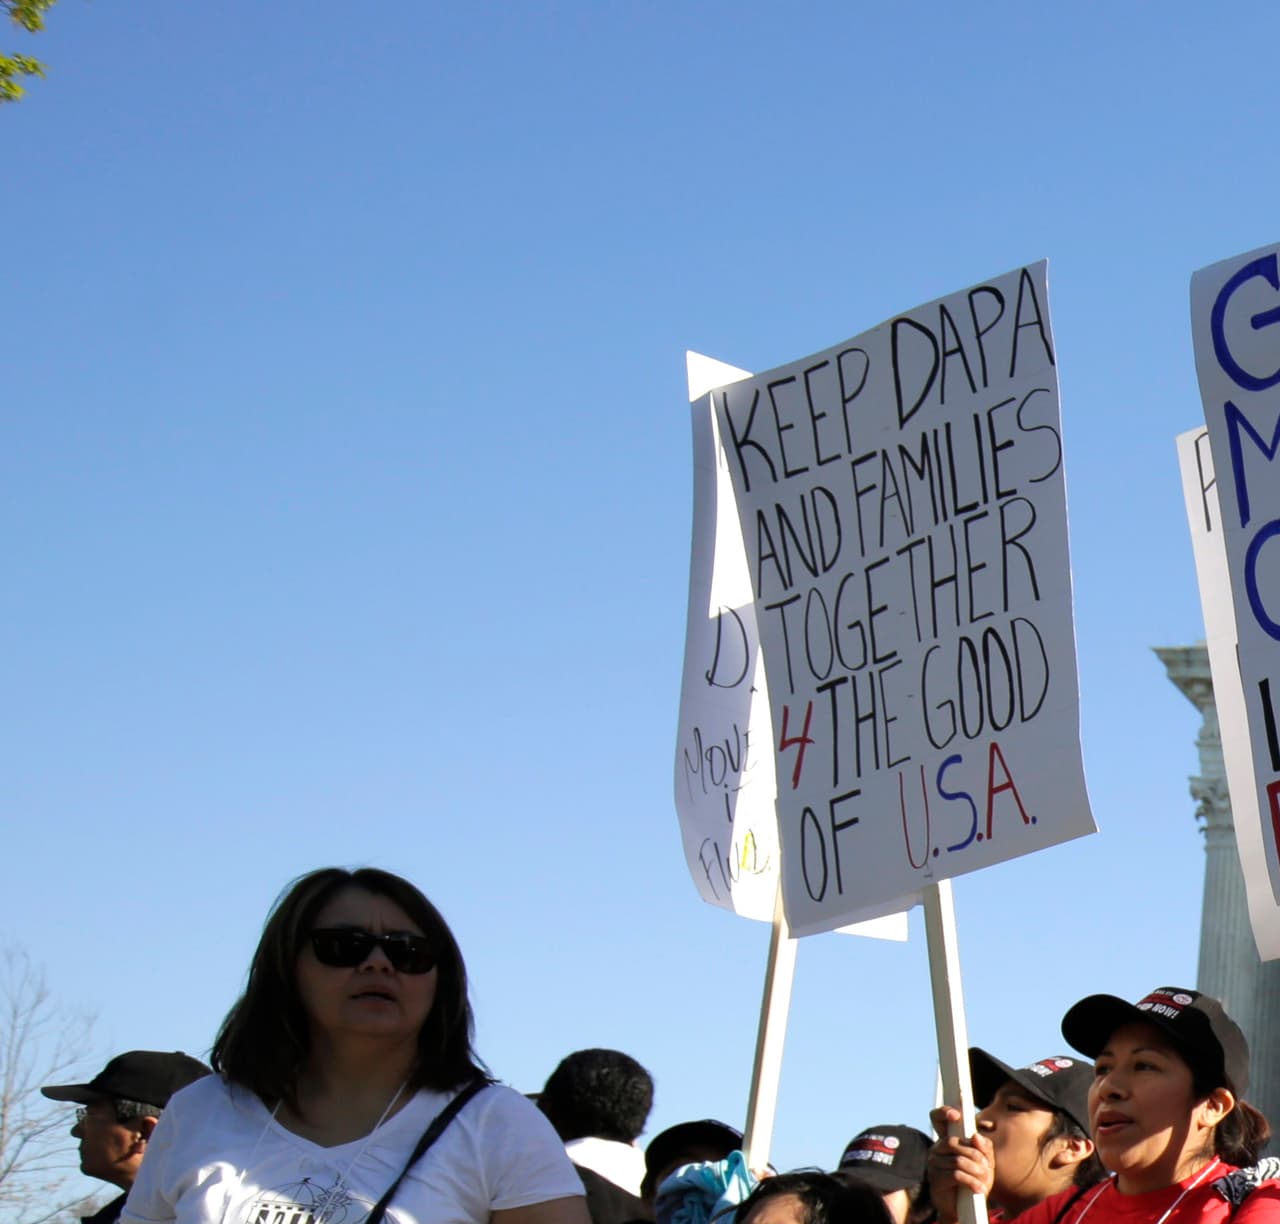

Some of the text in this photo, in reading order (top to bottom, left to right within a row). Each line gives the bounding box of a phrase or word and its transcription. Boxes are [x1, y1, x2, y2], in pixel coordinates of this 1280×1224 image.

[723, 268, 1055, 492] KEEP DAPA
[756, 485, 843, 599] AND
[851, 389, 1062, 557] FAMILIES
[765, 496, 1041, 694] TOGETHER
[780, 616, 1049, 790] 4 THE GOOD
[800, 789, 862, 902] OF
